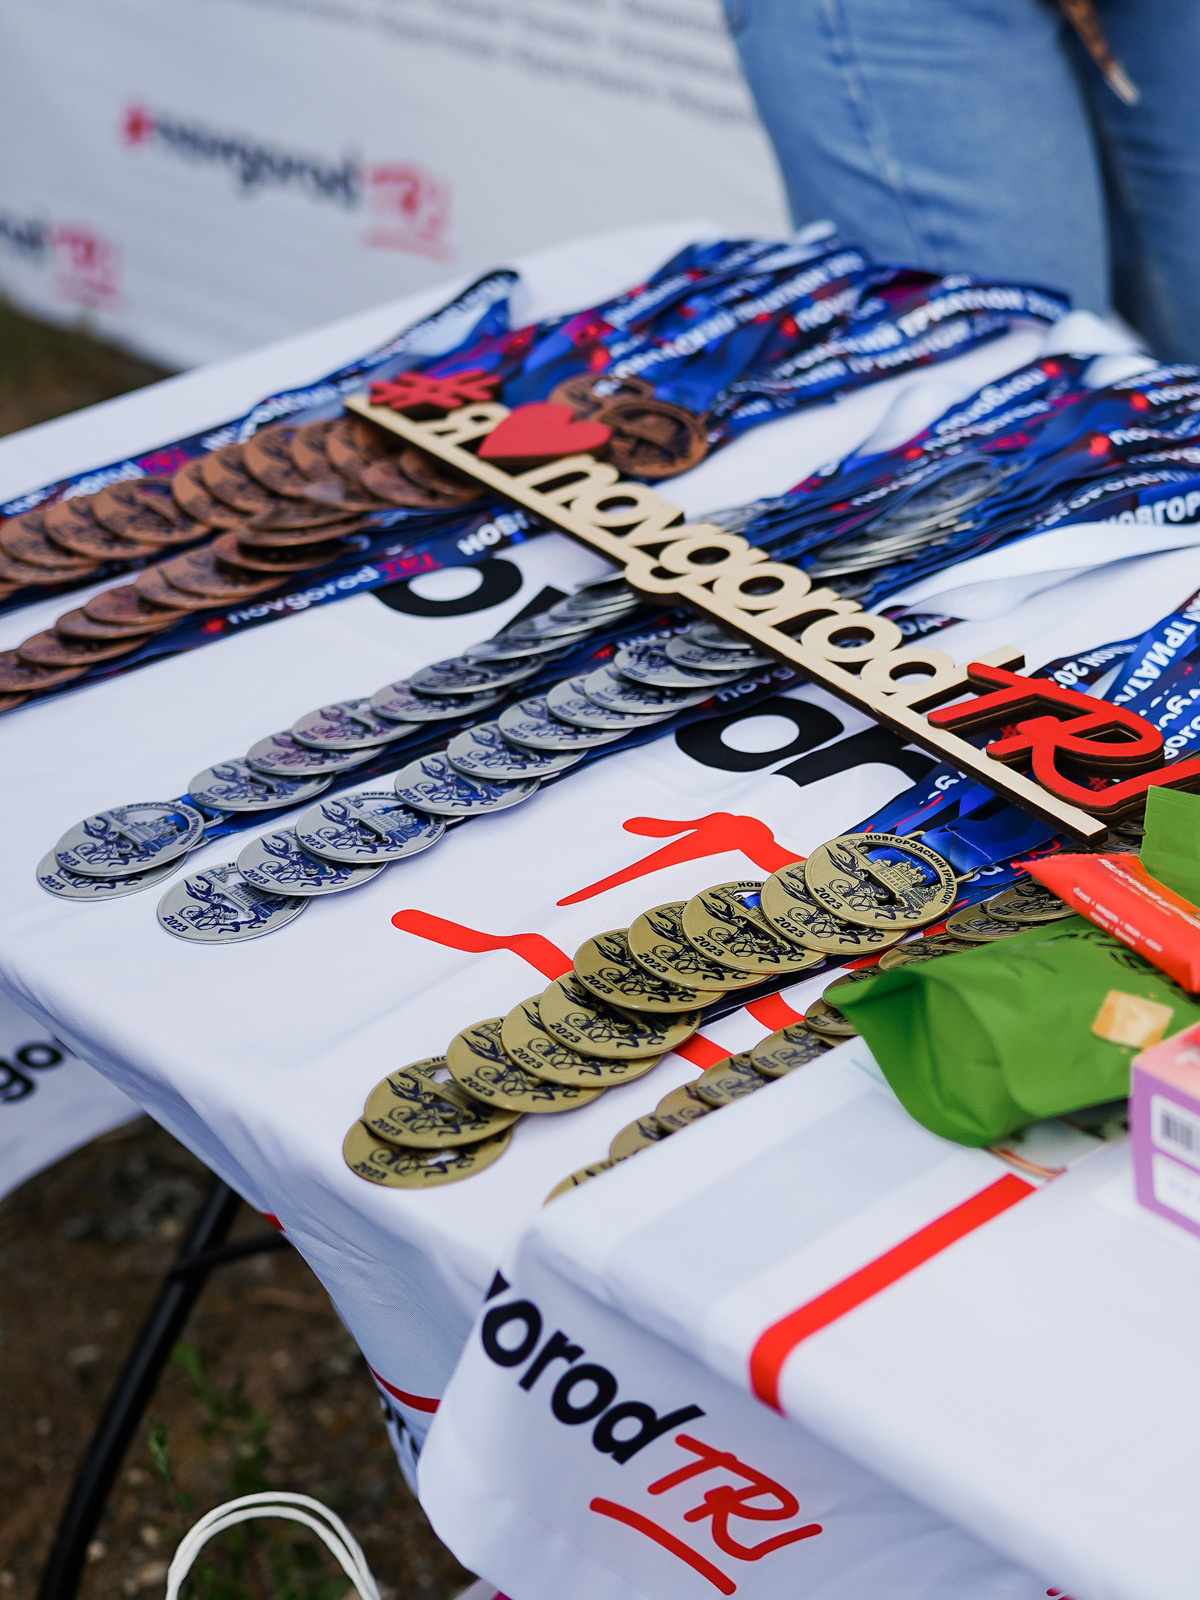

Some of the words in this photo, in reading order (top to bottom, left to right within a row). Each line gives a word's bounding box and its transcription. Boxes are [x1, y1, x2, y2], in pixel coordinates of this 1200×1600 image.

[504, 727, 530, 739] 2023
[452, 756, 478, 769] 2023
[300, 834, 326, 849] 2023
[56, 852, 82, 868] 2023
[865, 834, 949, 871] НОВГОРОДСКИЙ
[40, 875, 65, 891] 2023
[242, 869, 268, 886] 2023
[814, 886, 842, 910] 2023
[162, 915, 190, 933] 2023
[773, 915, 806, 938] 2023
[693, 935, 724, 957] 2023
[637, 952, 669, 974] 2023
[583, 974, 614, 995] 2023
[550, 1021, 582, 1045] 2023
[512, 1047, 543, 1070] 2023
[460, 1076, 495, 1097] 2023
[372, 1118, 403, 1137] 2023
[353, 1161, 388, 1180] 2023
[481, 1268, 706, 1465] orod
[648, 1433, 823, 1561] TRI
